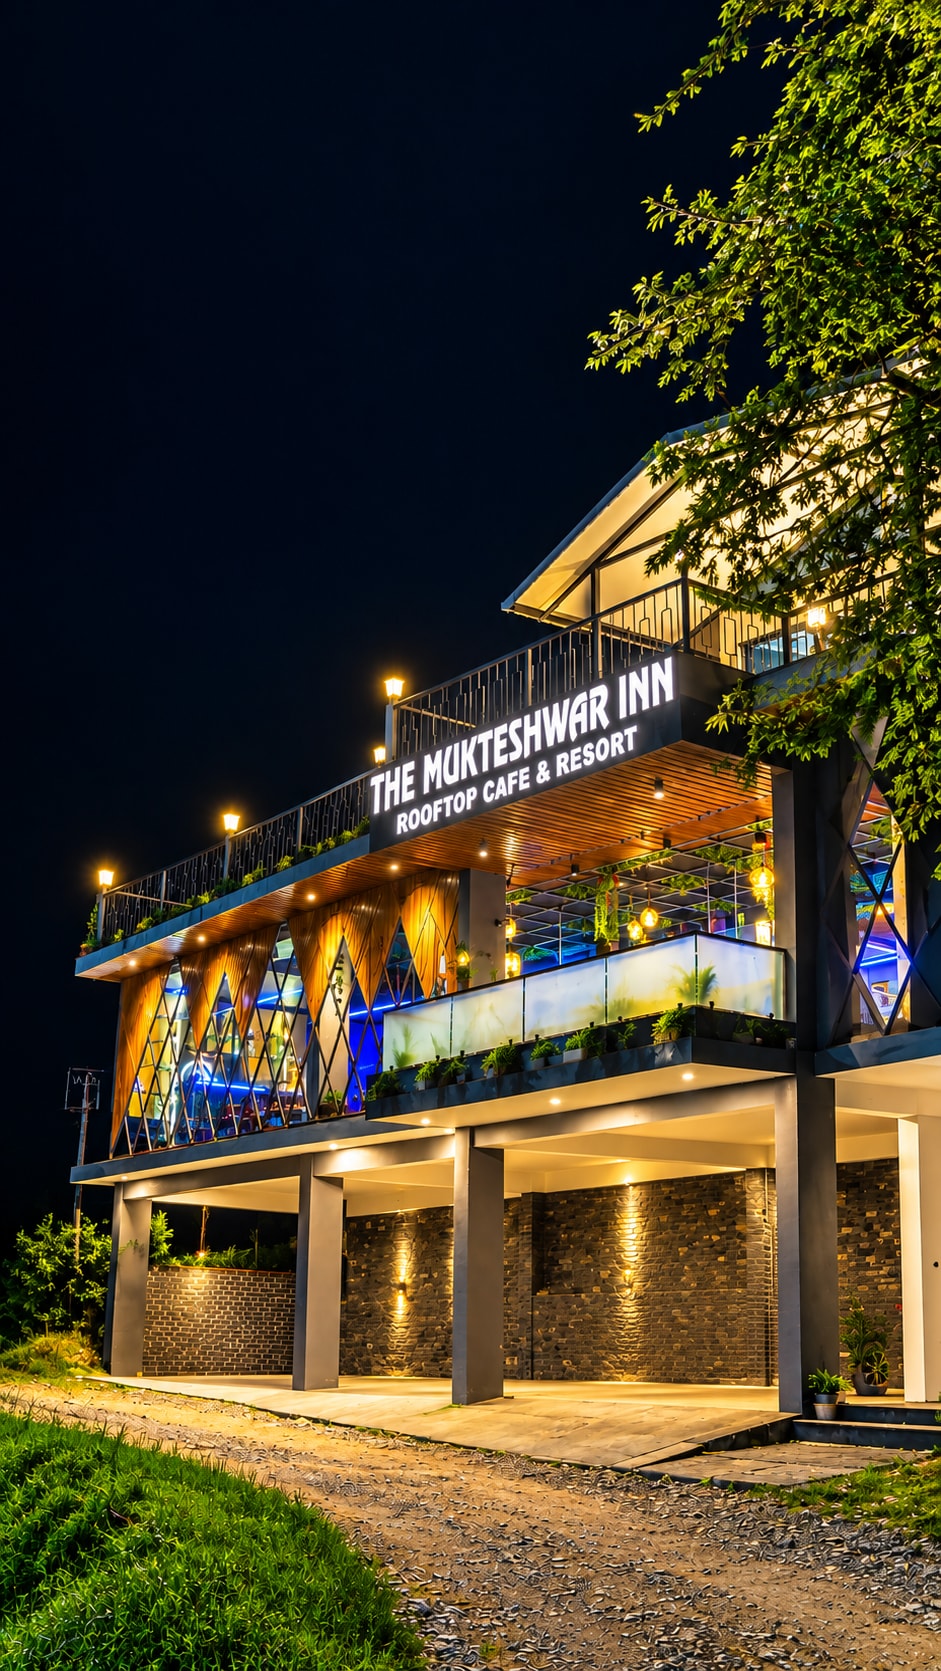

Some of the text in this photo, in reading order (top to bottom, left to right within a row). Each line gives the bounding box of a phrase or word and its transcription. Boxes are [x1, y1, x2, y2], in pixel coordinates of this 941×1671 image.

[369, 656, 674, 815] THE MUKTESHWAR INN
[396, 724, 639, 835] ROOFTOP CAFE & RESORT
